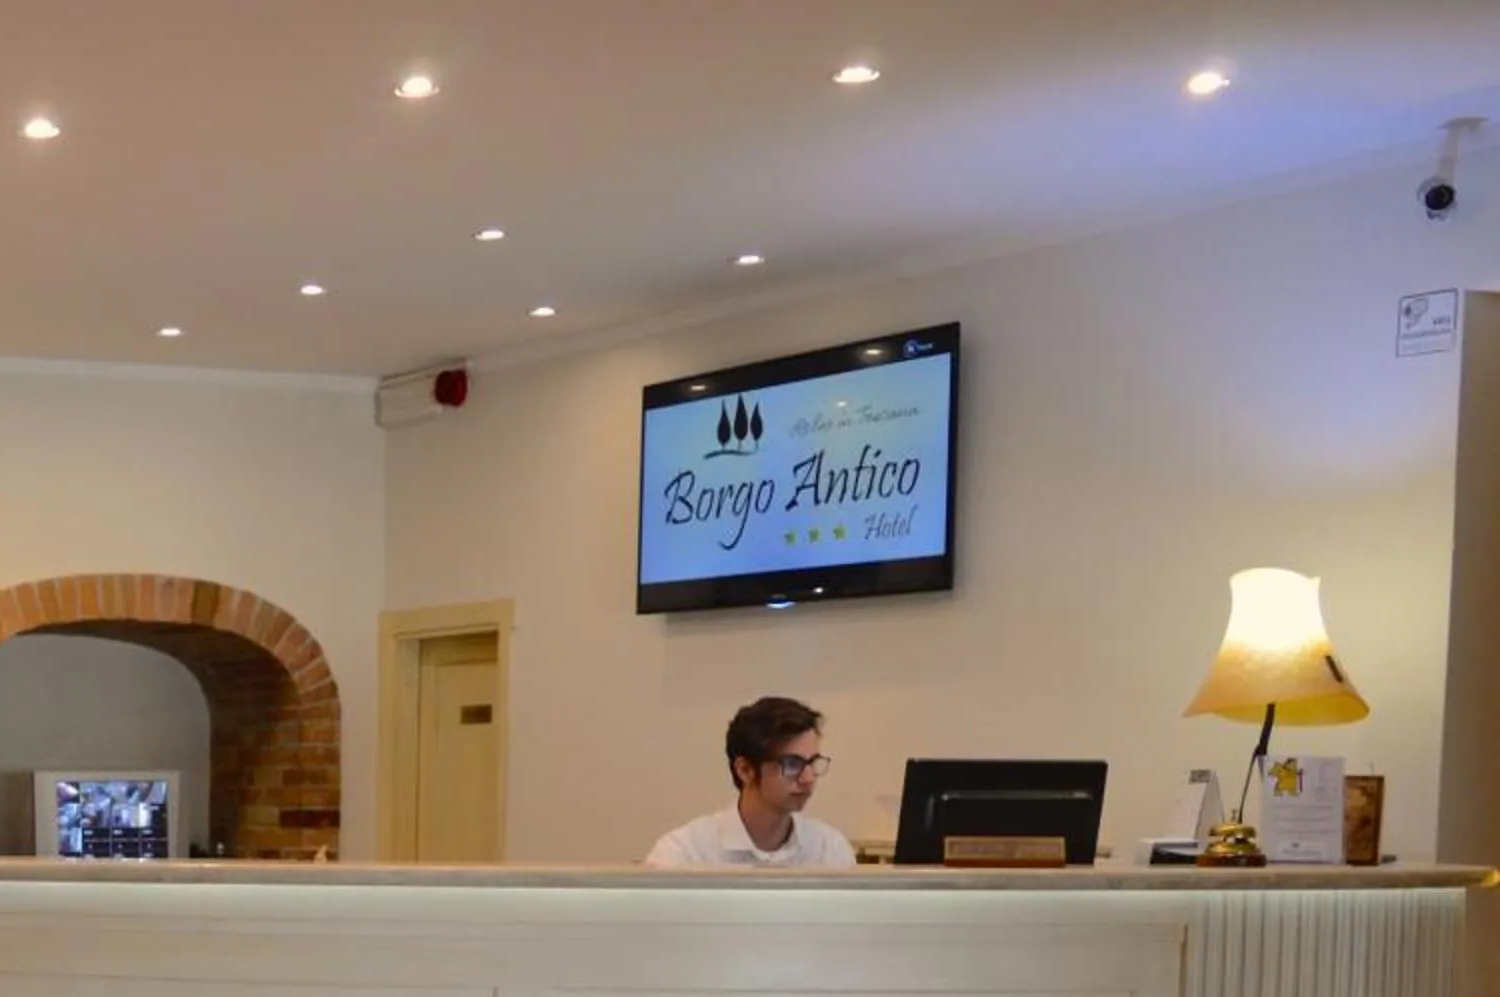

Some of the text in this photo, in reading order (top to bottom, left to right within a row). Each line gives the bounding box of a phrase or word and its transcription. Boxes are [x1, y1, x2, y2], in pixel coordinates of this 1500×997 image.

[664, 444, 921, 551] Borgo Antico
[864, 504, 919, 541] Hotel
